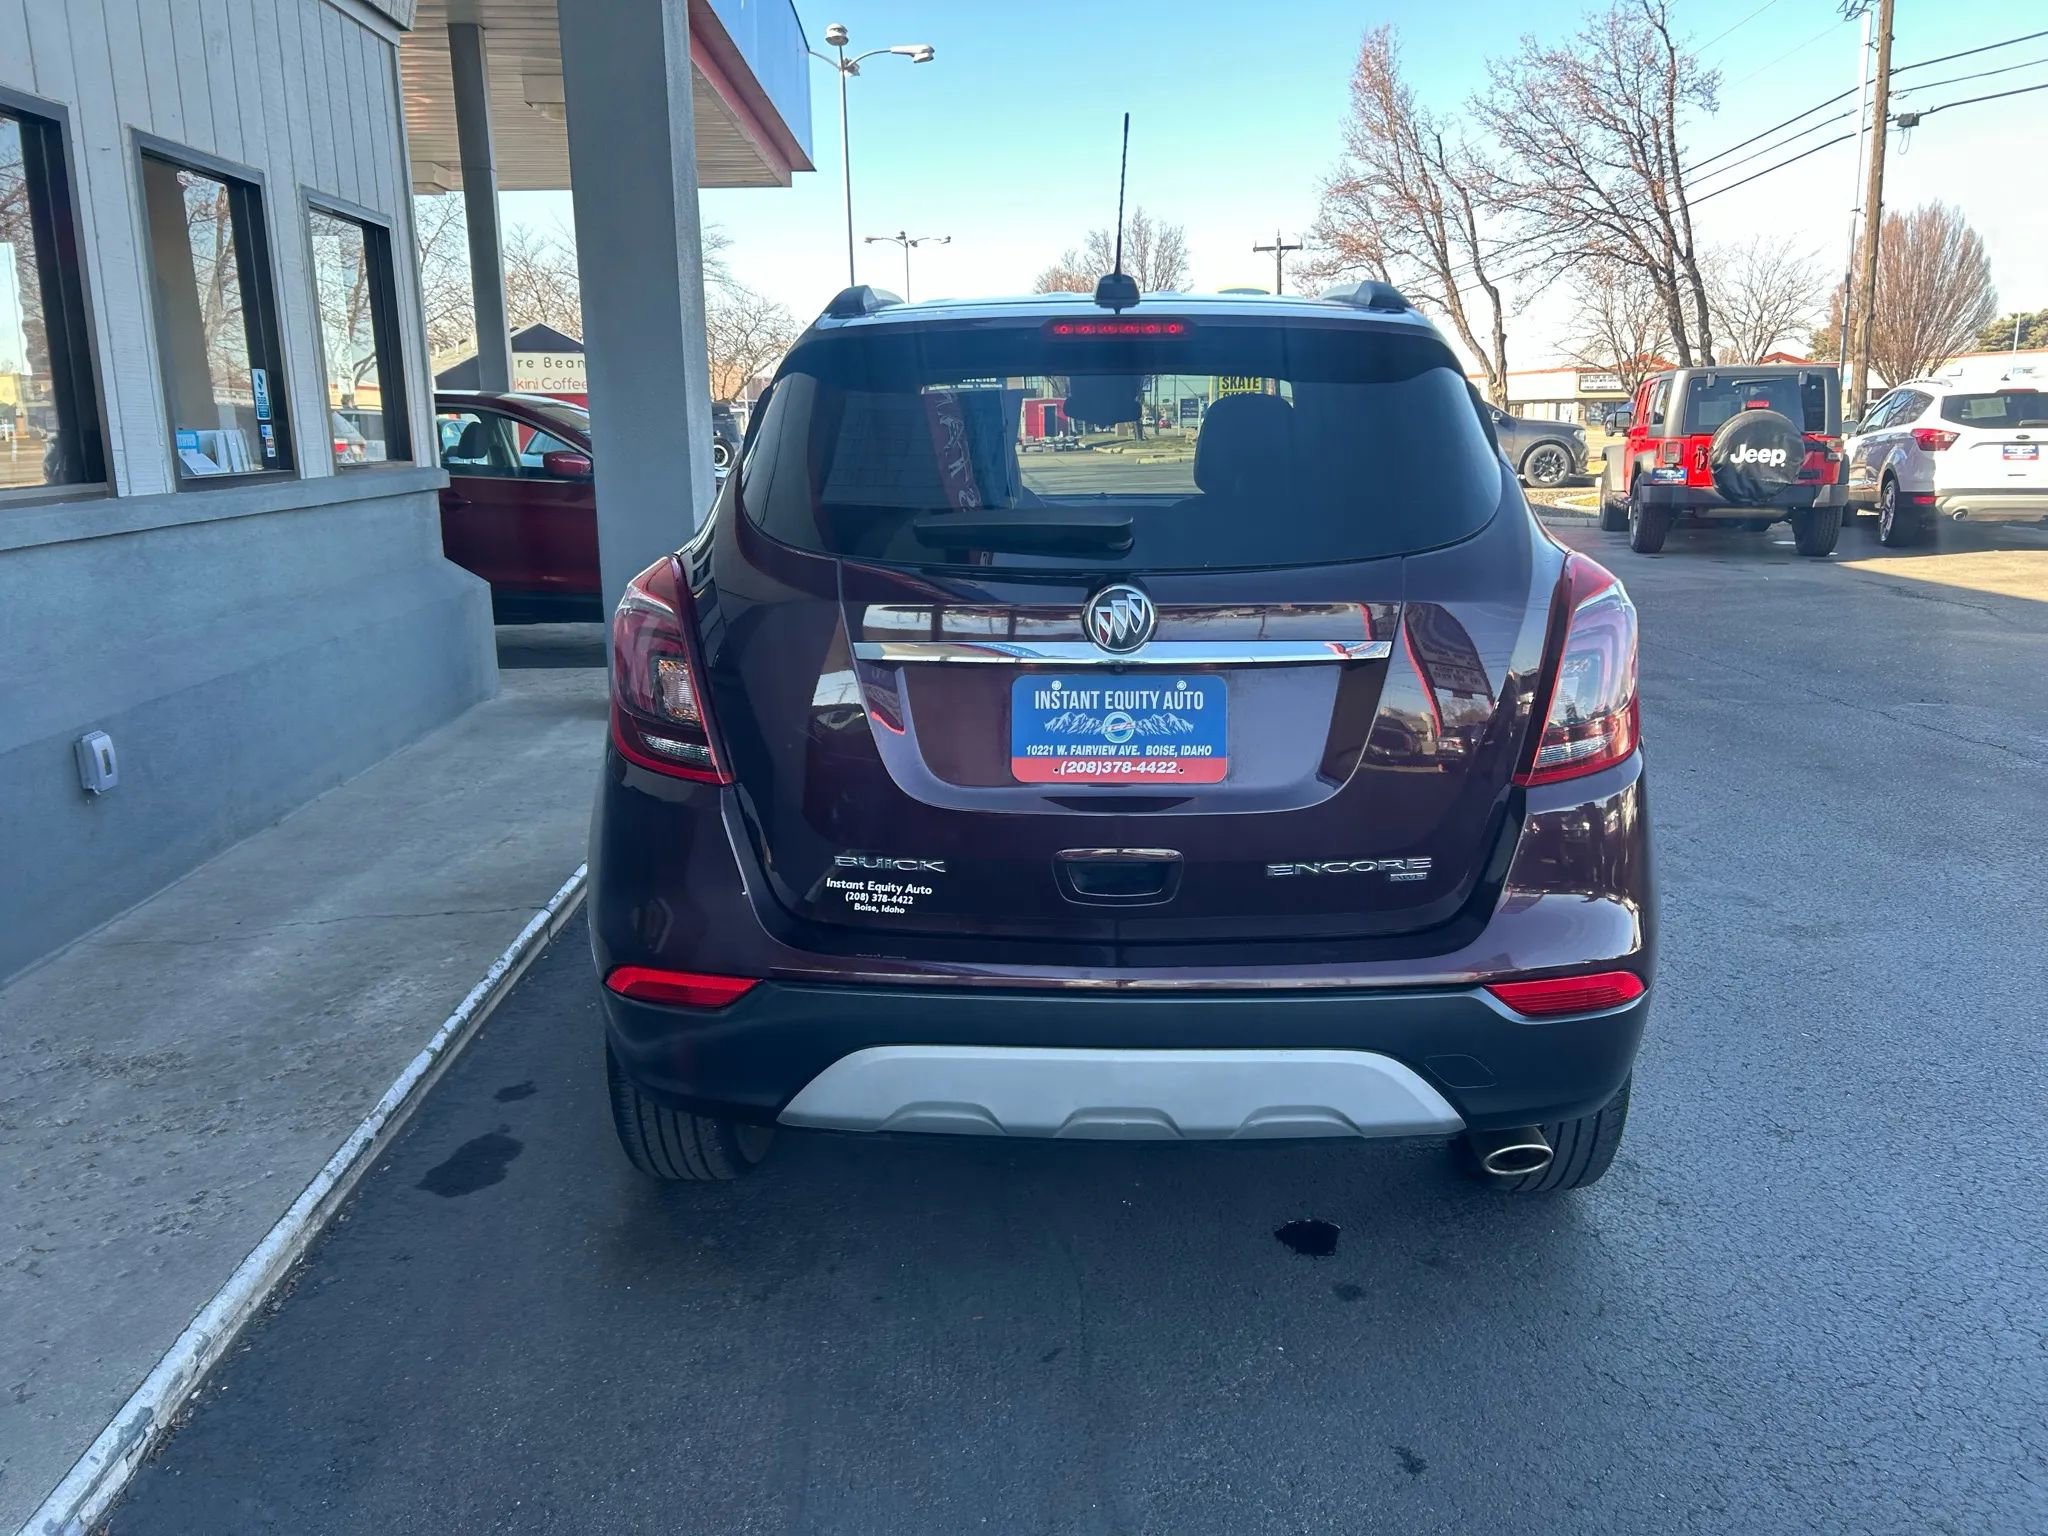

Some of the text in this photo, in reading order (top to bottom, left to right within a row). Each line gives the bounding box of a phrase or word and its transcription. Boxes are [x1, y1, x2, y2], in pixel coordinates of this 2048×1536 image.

[541, 377, 588, 390] Coffee
[1222, 376, 1261, 390] SKATE
[1730, 444, 1787, 467] Jeep
[1035, 690, 1204, 711] INSTANT EQUITY AUTO
[1026, 745, 1212, 758] 10221 W. FAIRVIEW AVE. BOISE, IDAHO
[1060, 761, 1177, 775] (208)378-4422
[834, 855, 946, 873] BUICK
[1266, 857, 1432, 876] ENCORE
[826, 878, 933, 895] Instant Equity Auto
[845, 891, 914, 905] (208) 378-4422
[854, 902, 905, 914] Boise, Idaho
